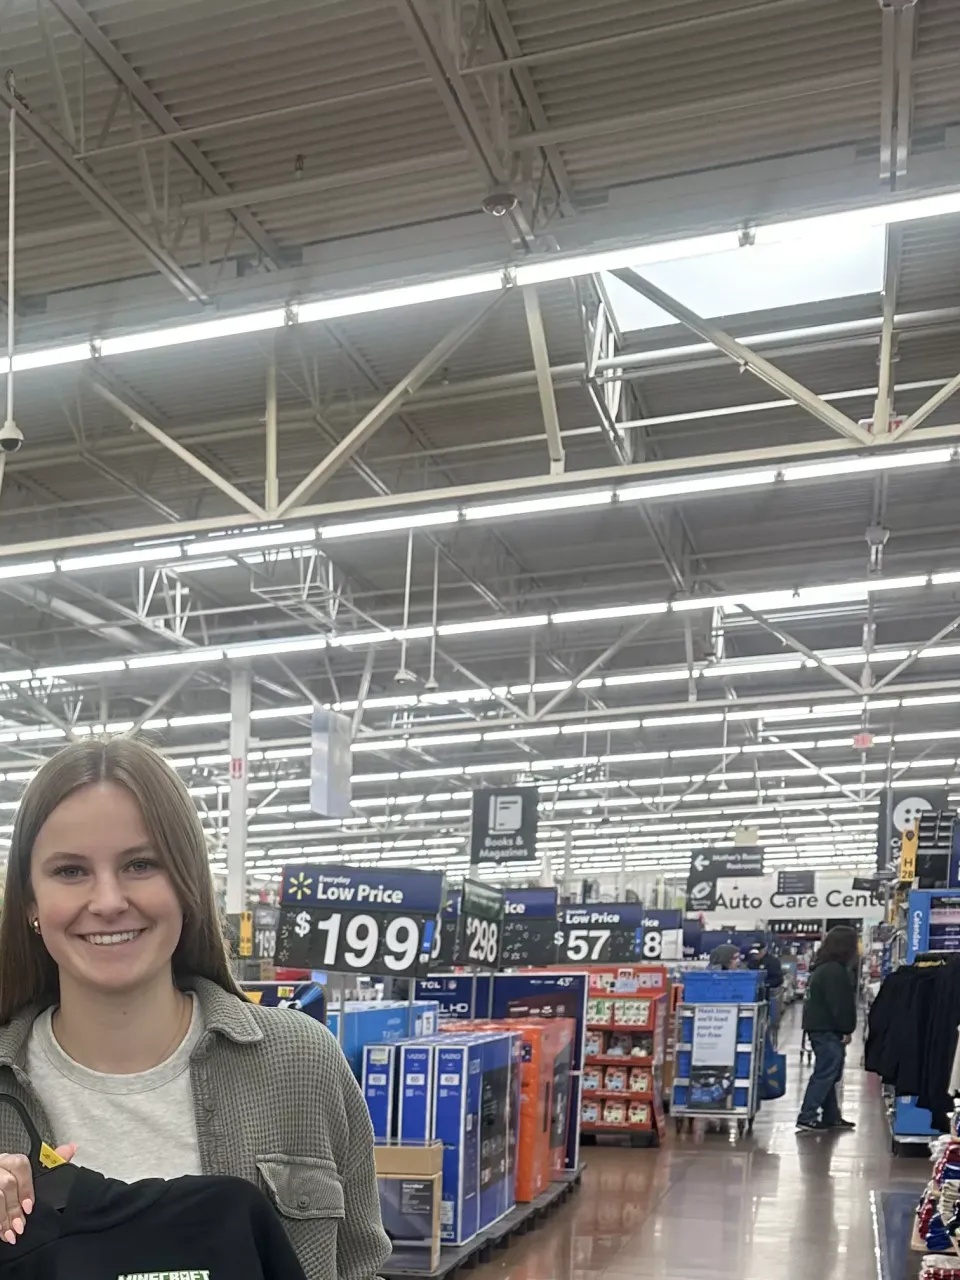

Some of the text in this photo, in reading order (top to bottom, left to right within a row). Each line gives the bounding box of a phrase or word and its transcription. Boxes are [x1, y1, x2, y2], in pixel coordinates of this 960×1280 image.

[484, 835, 524, 847] Books &
[479, 847, 528, 860] Magazines
[904, 858, 913, 867] H
[319, 875, 351, 885] Everyday
[901, 870, 914, 880] 28
[317, 883, 403, 903] Low Price
[715, 893, 763, 910] Auto
[769, 892, 819, 909] Care
[566, 912, 620, 924] Low Price
[420, 981, 441, 989] TCL
